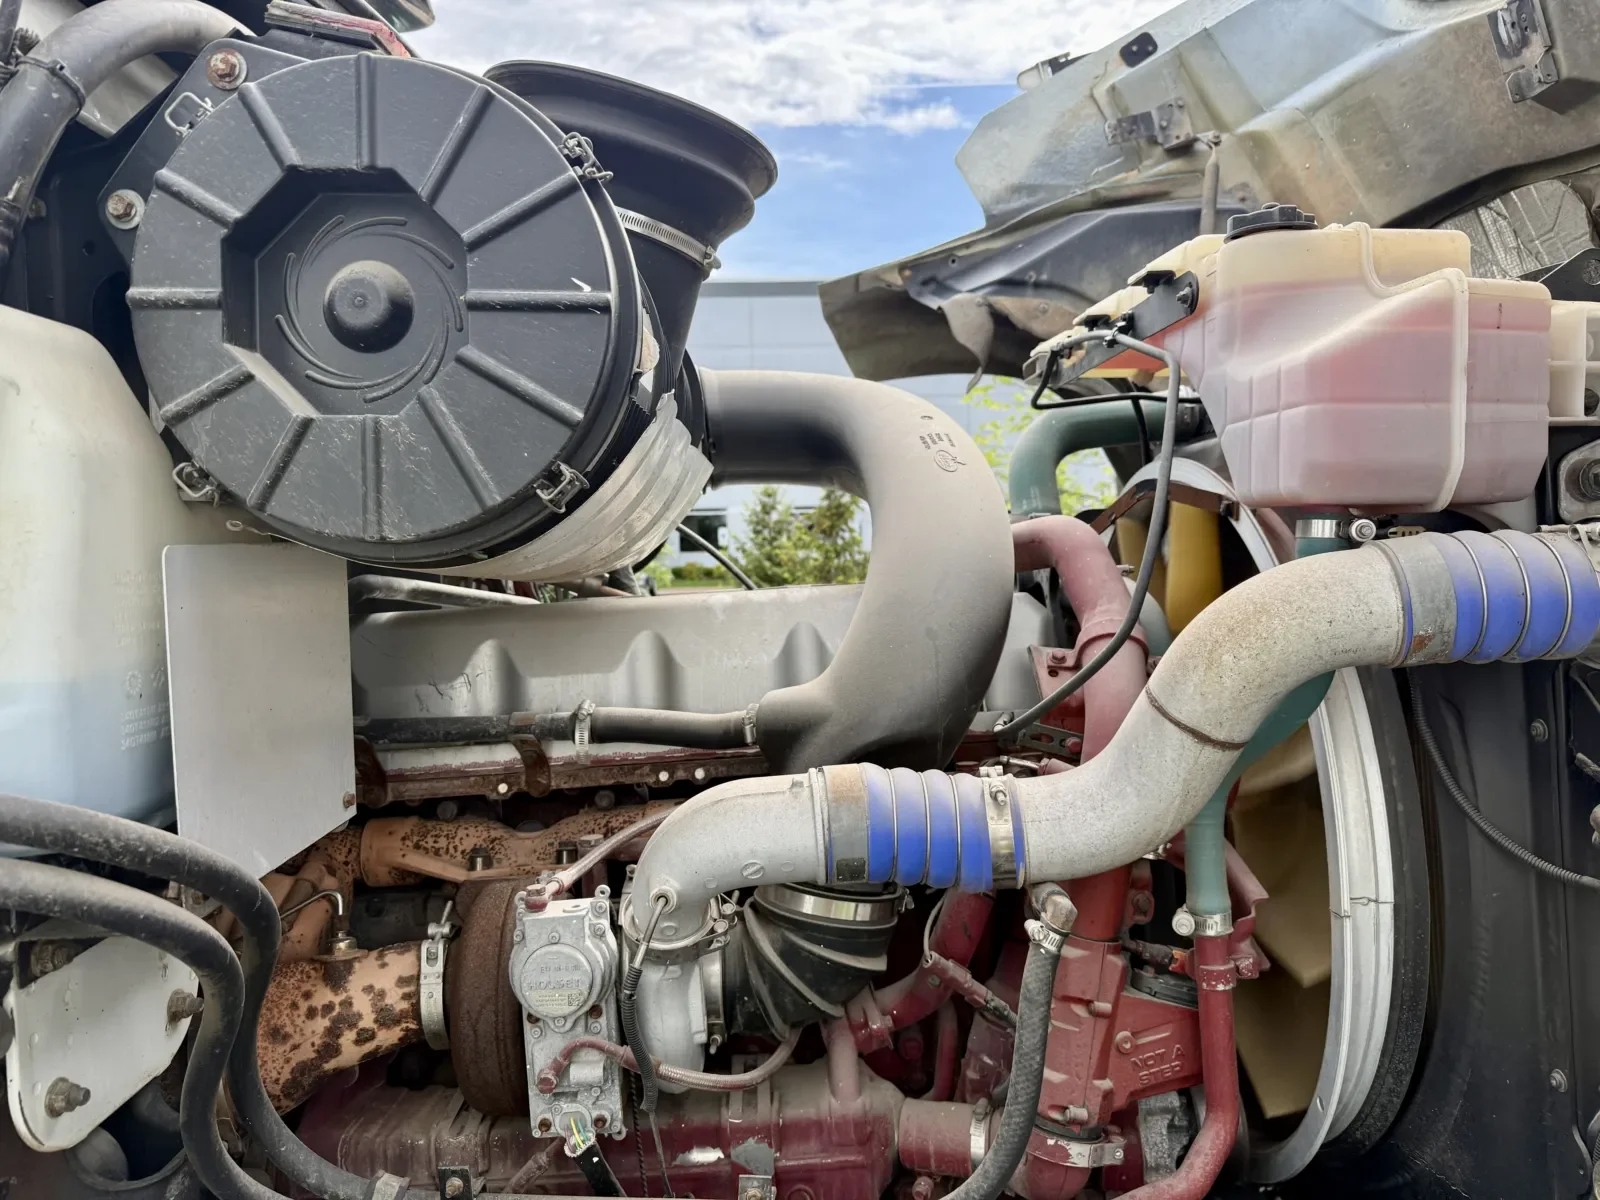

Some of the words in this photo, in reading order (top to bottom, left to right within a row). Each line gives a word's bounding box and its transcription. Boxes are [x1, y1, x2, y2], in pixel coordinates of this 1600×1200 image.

[1130, 1048, 1168, 1071] NOT
[1171, 1044, 1185, 1060] A
[1138, 1061, 1181, 1085] STEP
